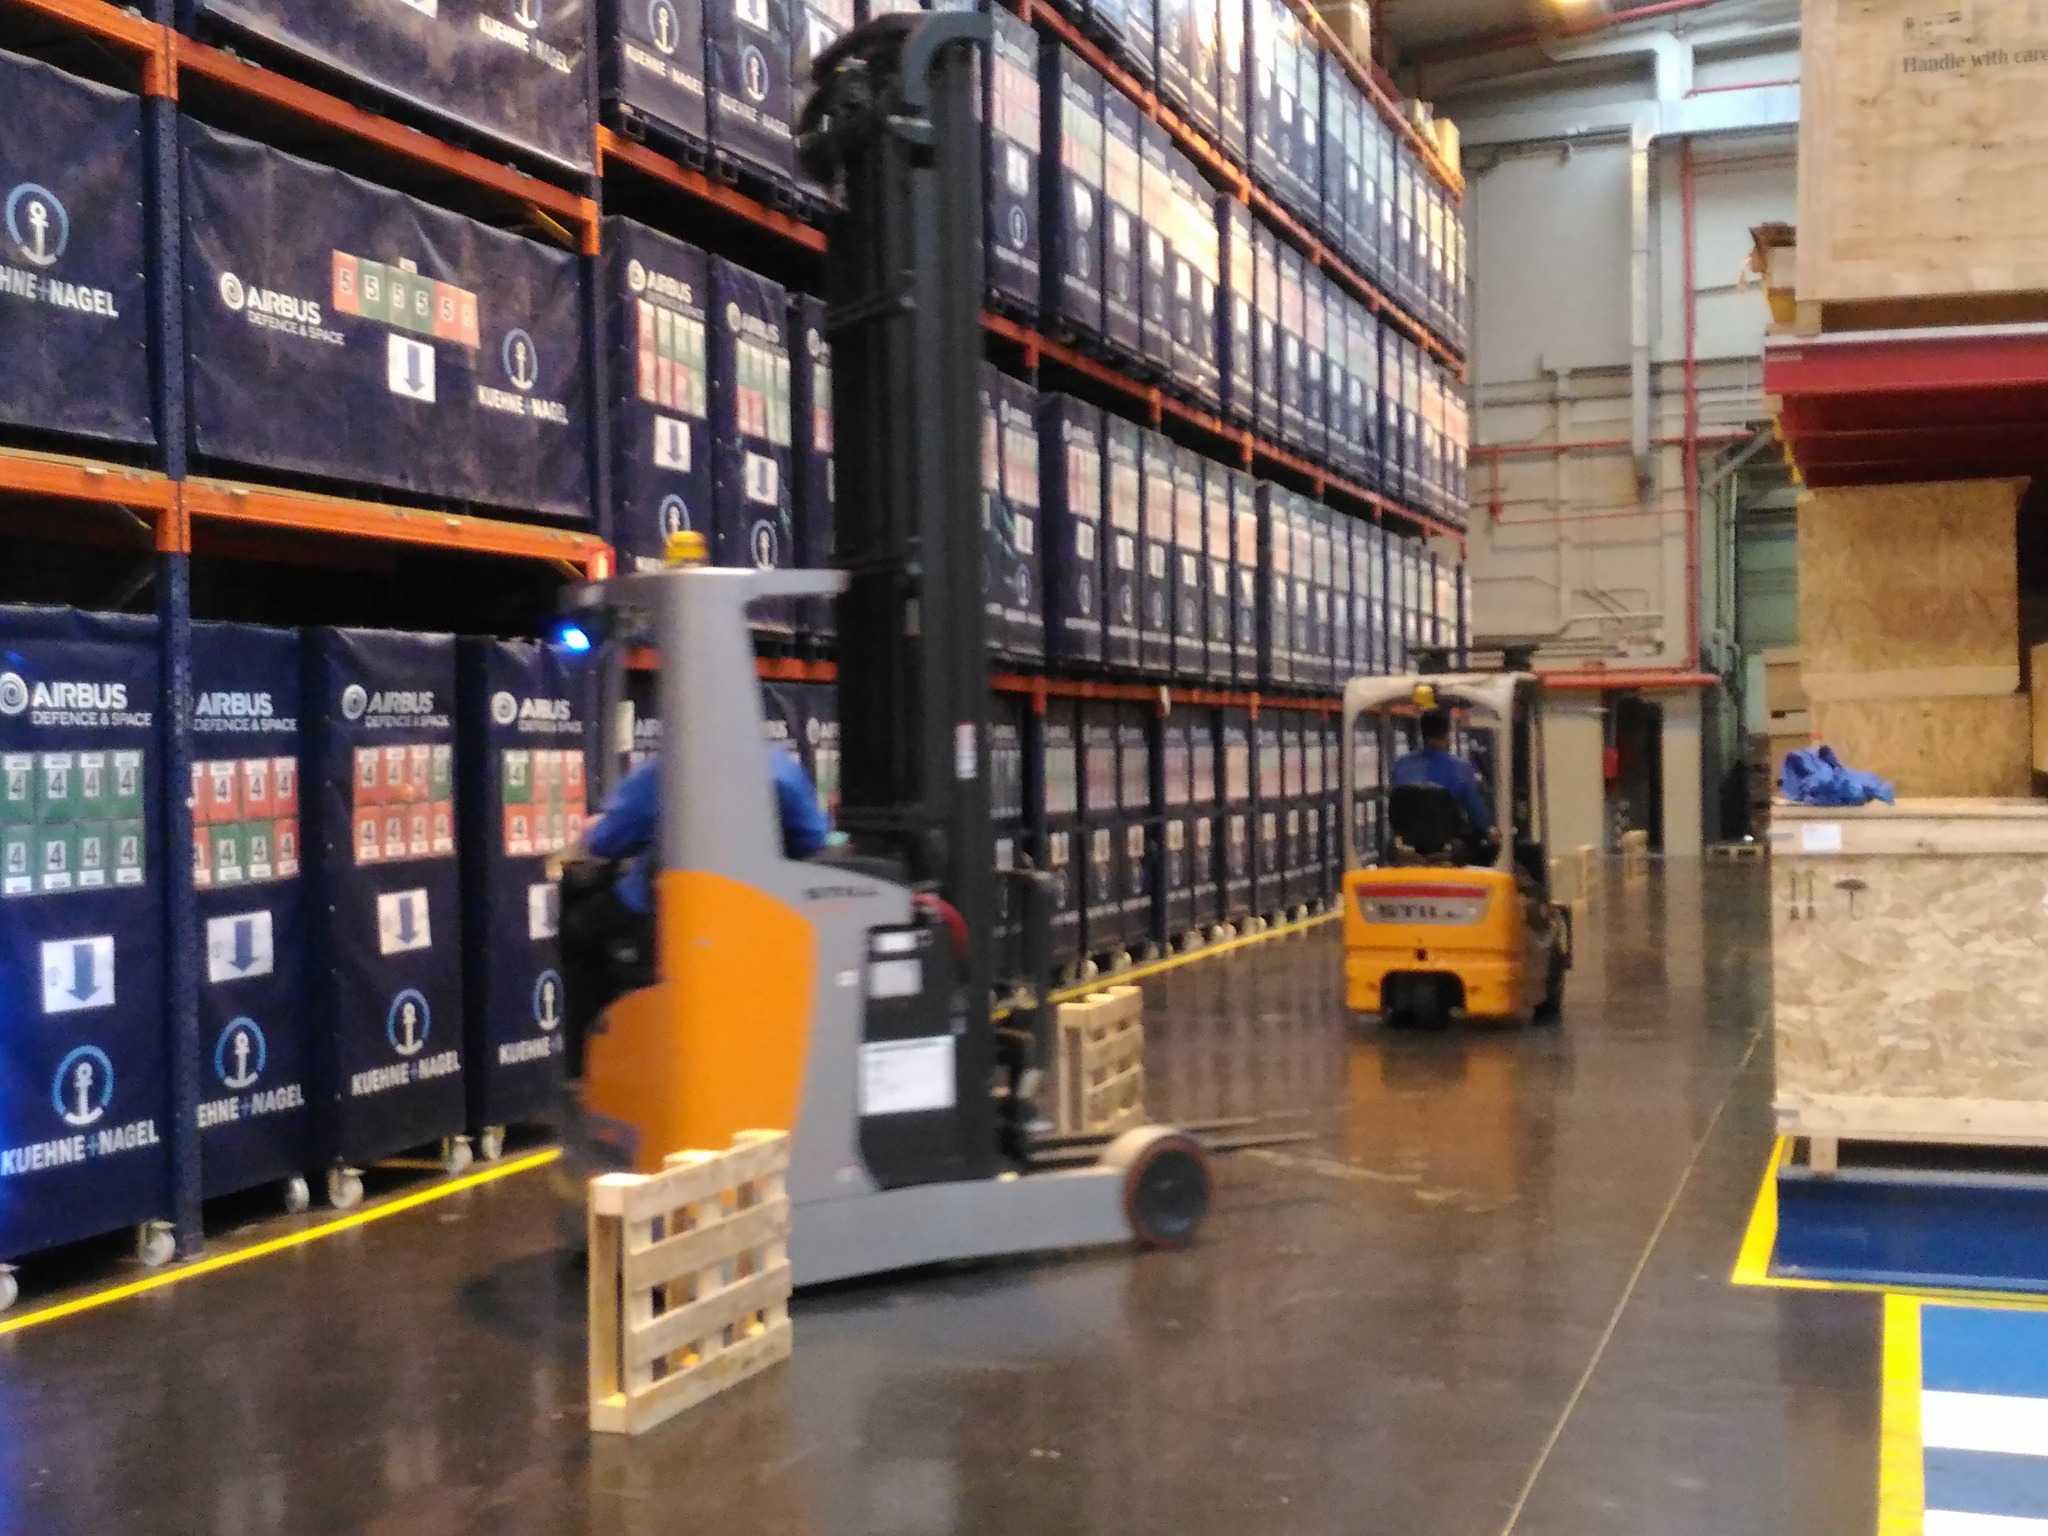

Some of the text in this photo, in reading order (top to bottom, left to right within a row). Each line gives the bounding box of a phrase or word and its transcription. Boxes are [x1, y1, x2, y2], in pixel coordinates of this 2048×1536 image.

[1903, 48, 2048, 72] Handle with care
[247, 286, 322, 325] AIRBUS
[32, 682, 128, 709] AIRBUS
[196, 692, 274, 717] AIRBUS
[367, 691, 435, 714] AIRBUS
[32, 712, 152, 727] DEFENCE & SPACE
[194, 719, 249, 732] DEFENCE
[261, 718, 297, 732] SPACE
[1, 1120, 159, 1175] KUEHNE+NAGEL
